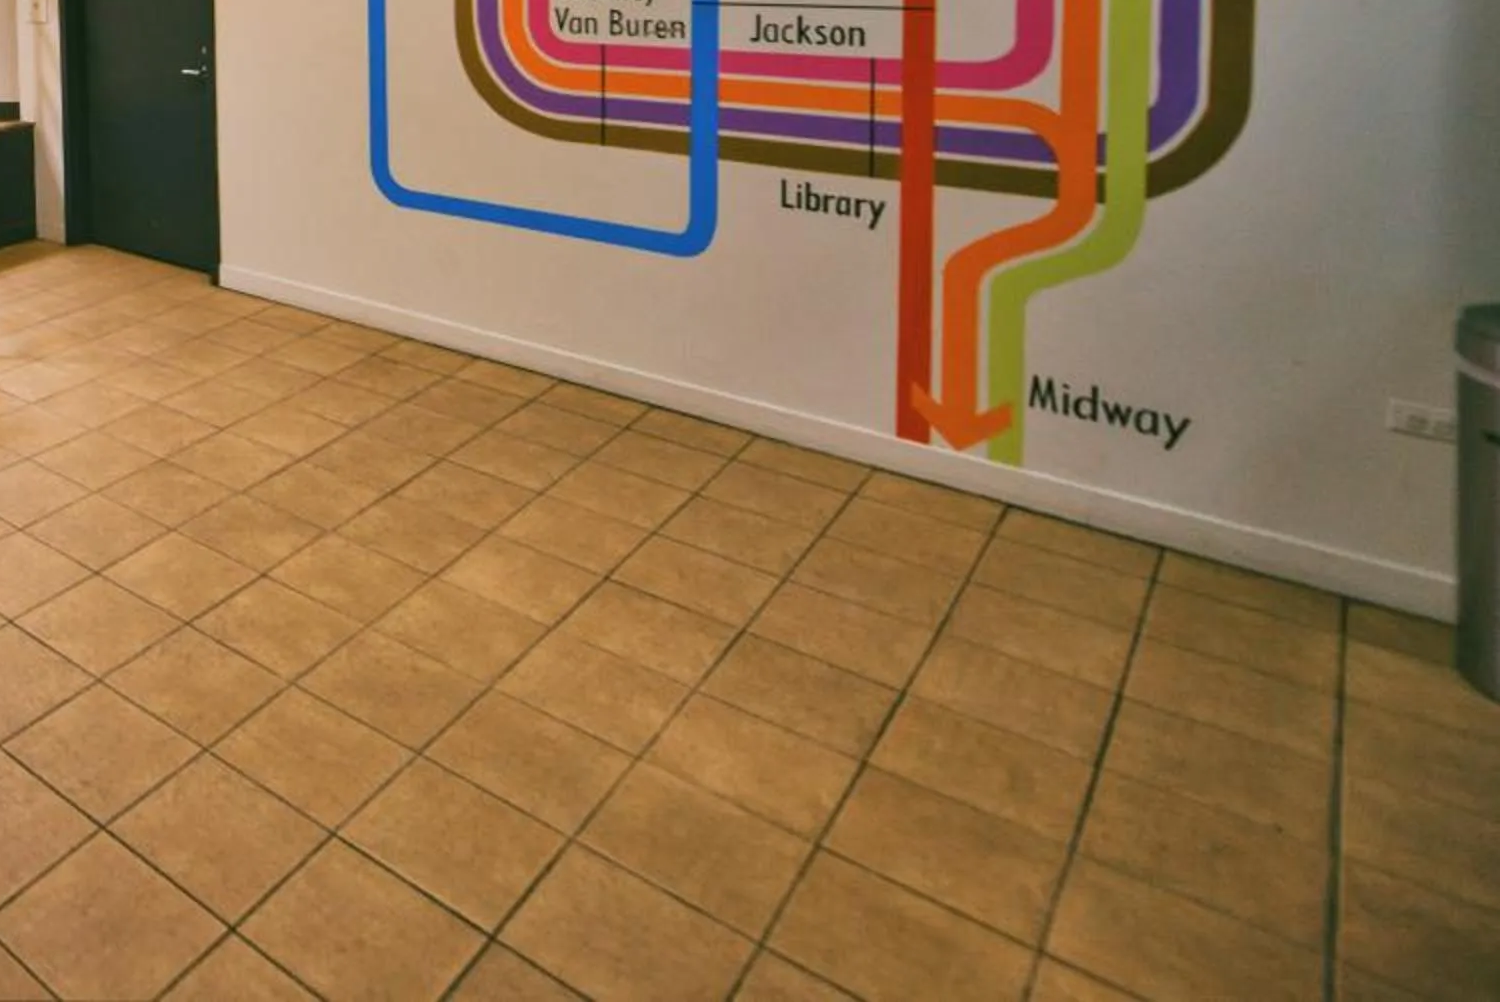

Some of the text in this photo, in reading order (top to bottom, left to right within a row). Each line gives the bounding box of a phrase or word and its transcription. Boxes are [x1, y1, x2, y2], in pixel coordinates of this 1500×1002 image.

[555, 7, 686, 40] Van Buren
[749, 14, 866, 47] Jackson
[781, 179, 886, 230] Library
[1029, 375, 1191, 450] Midway
